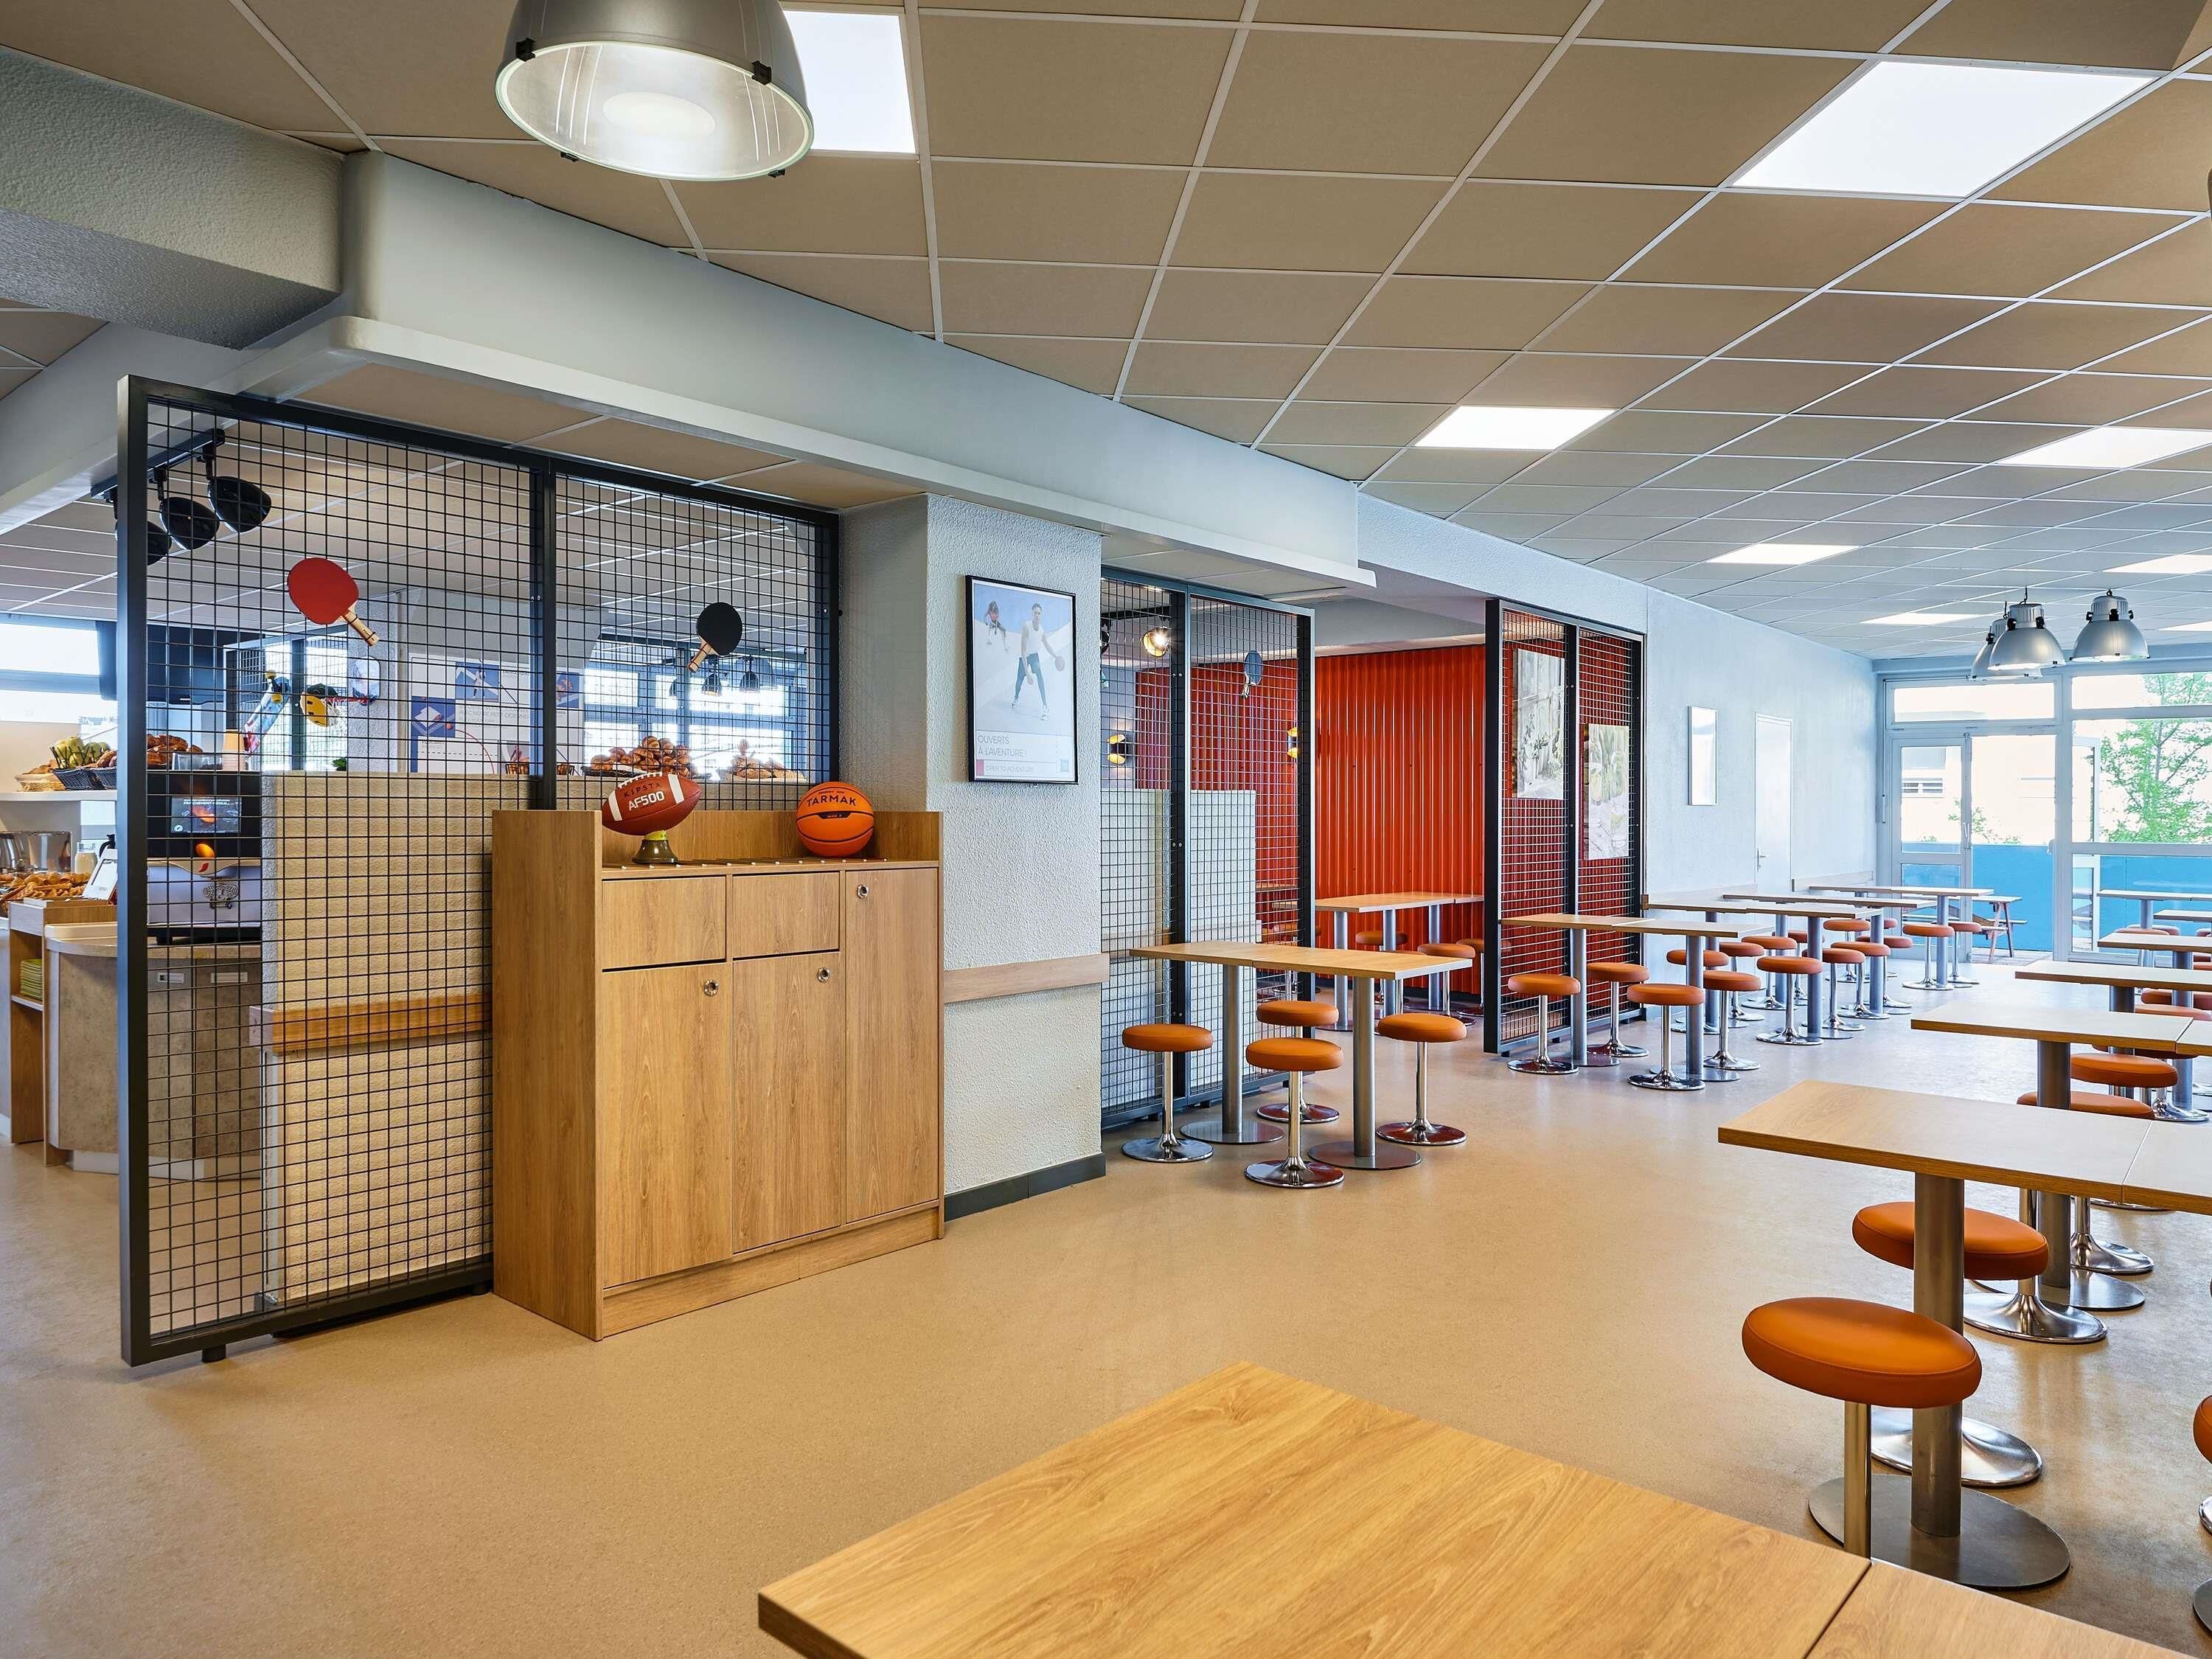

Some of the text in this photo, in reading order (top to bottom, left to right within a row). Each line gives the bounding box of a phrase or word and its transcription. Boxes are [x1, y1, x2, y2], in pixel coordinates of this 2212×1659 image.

[978, 735, 1009, 745] OUVERTS
[624, 783, 661, 798] KIPSTA
[629, 790, 665, 810] AF500
[807, 795, 856, 807] TARMAK
